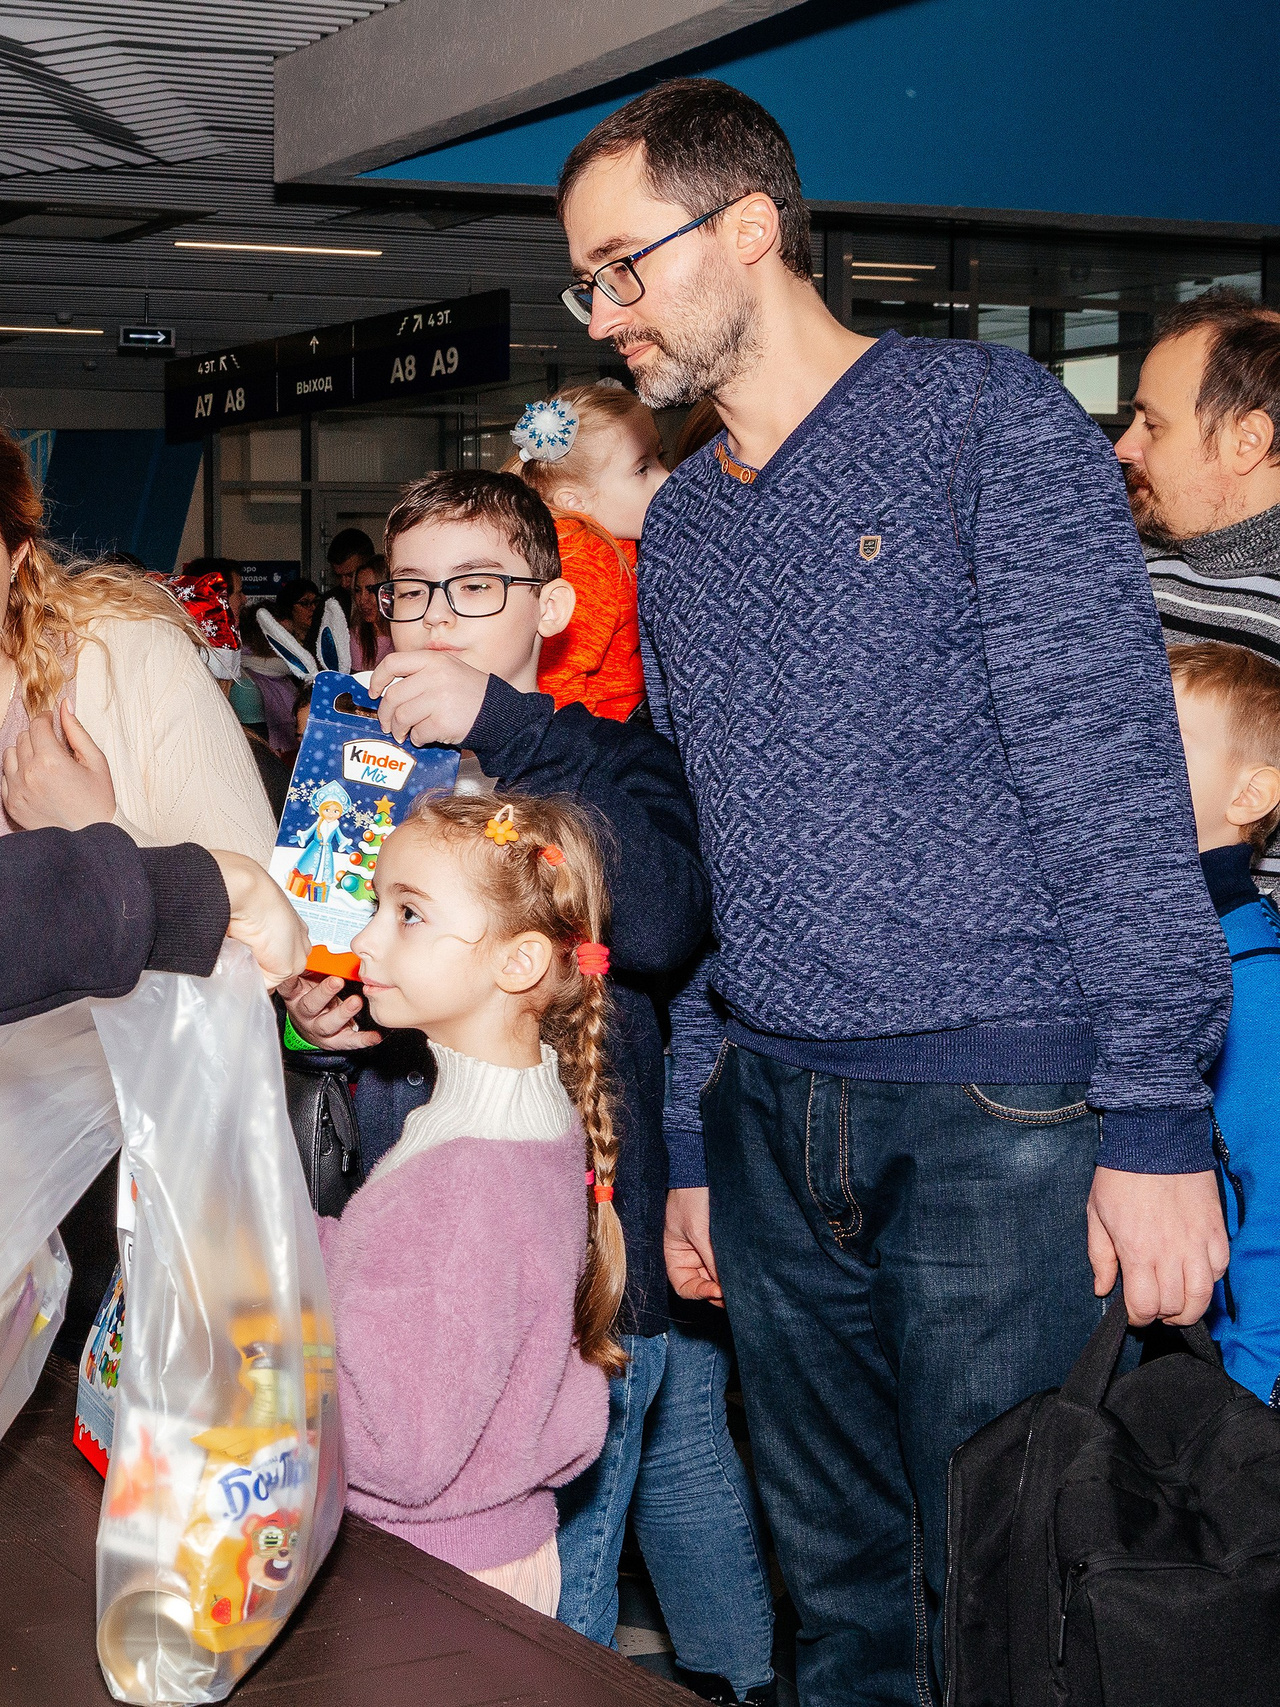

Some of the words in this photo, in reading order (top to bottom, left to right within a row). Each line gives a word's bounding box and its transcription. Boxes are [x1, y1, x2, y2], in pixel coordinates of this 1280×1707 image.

[390, 354, 417, 384] A8
[430, 346, 459, 377] A9
[296, 375, 333, 395] ВЫХОД
[195, 393, 214, 418] A7
[224, 387, 246, 413] A8
[350, 745, 407, 772] Kinder
[361, 766, 388, 784] Mix
